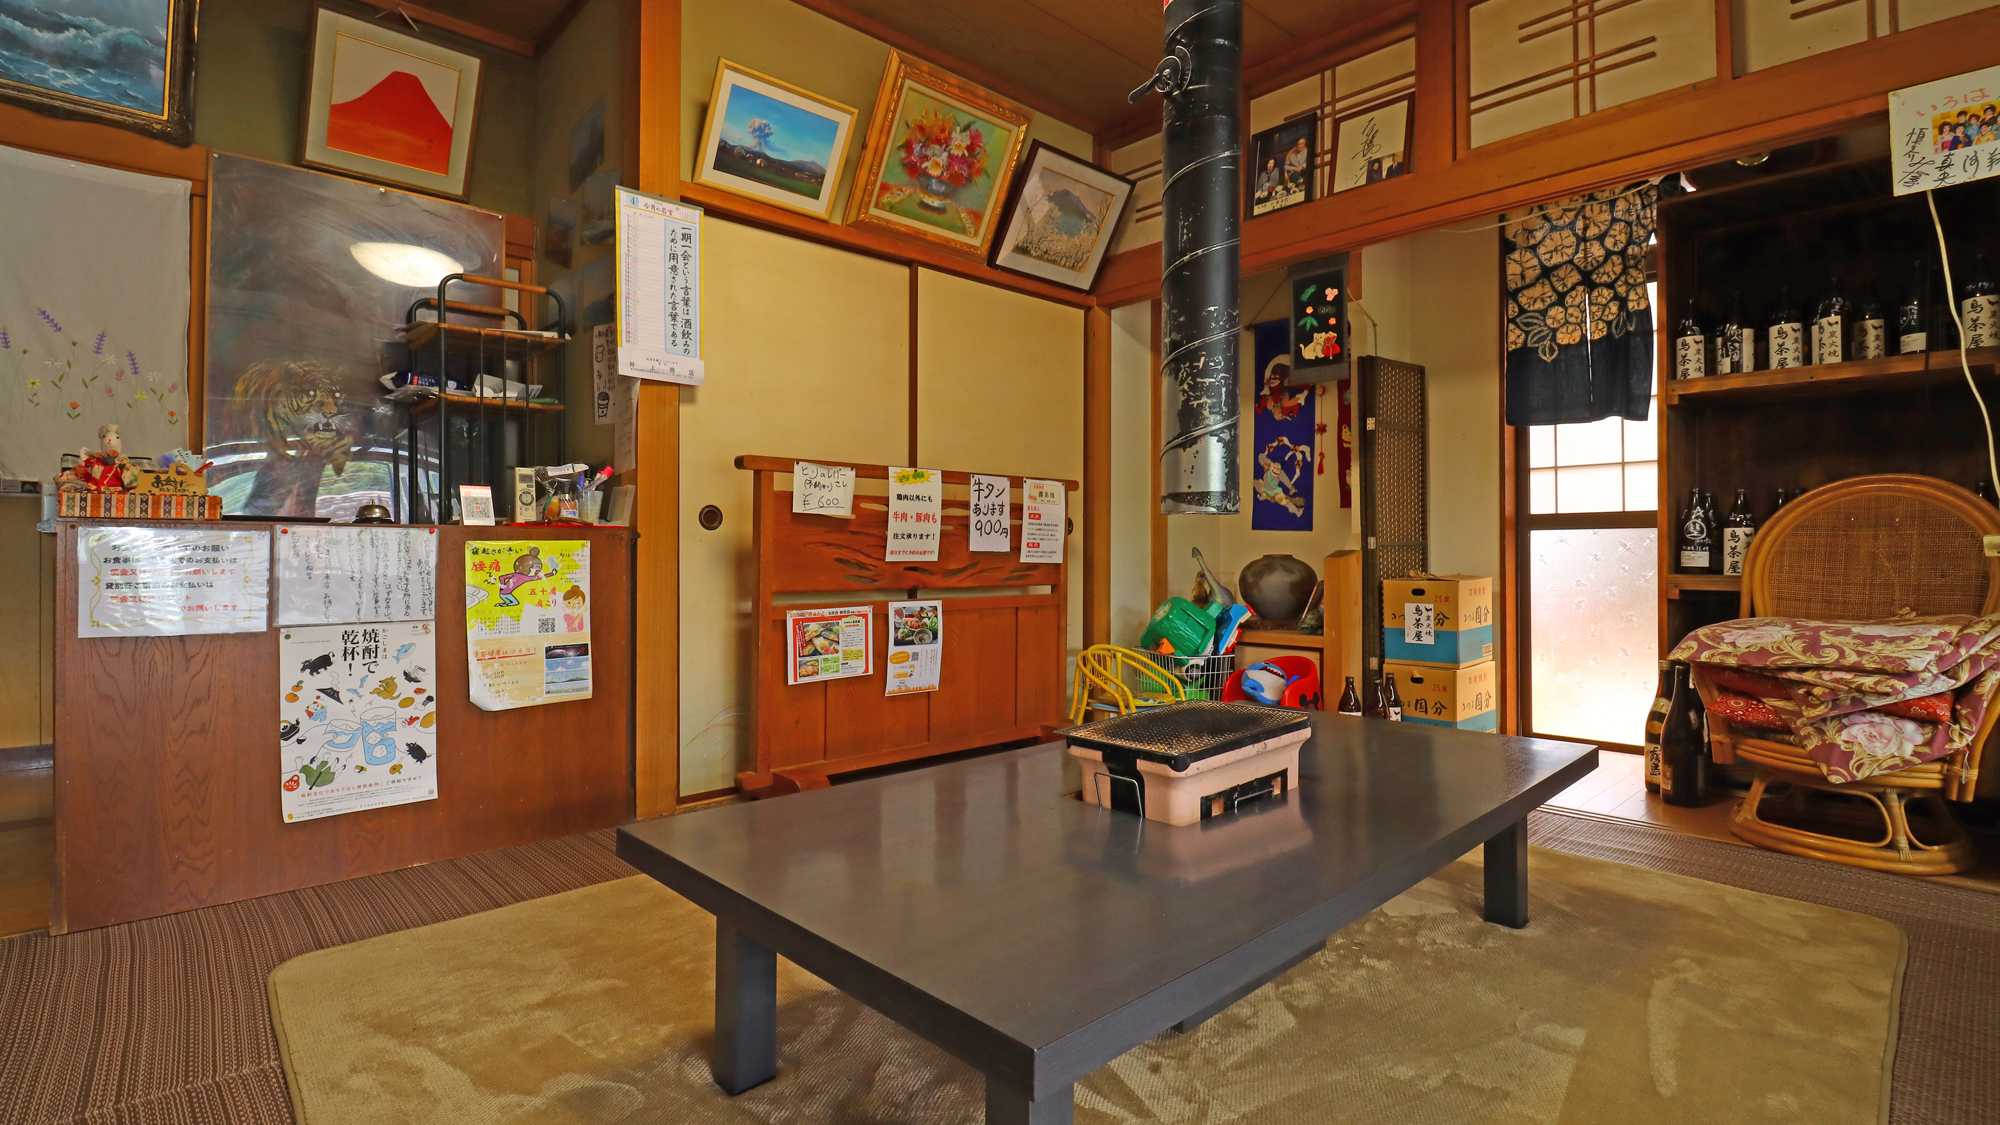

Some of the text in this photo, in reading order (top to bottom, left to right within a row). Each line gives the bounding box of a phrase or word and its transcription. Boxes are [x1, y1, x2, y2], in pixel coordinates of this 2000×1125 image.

[1916, 88, 1990, 116] いろは
[630, 197, 636, 205] 4
[668, 228, 679, 347] ために用意された言葉である
[1966, 299, 1985, 349] 鳥茶屋
[802, 466, 846, 479] とりのレバー
[972, 478, 1006, 502] 牛タン
[897, 494, 932, 502] 鶏肉以外にも
[972, 501, 1005, 516] あります
[892, 511, 938, 523] 牛肉・豚肉も
[975, 519, 1009, 538] 900円
[892, 532, 935, 540] 注文承ります！
[1727, 530, 1741, 574] 鳥茶屋
[471, 559, 501, 572] 腰痛
[529, 587, 557, 596] 五十肩
[535, 599, 557, 608] 肩こり
[1434, 595, 1450, 603] 25度
[179, 604, 238, 612] でお願いします
[1413, 605, 1424, 642] 鳥茶屋
[341, 630, 359, 676] 乾杯！
[362, 629, 379, 673] 焼酎で
[1433, 683, 1448, 693] 25度
